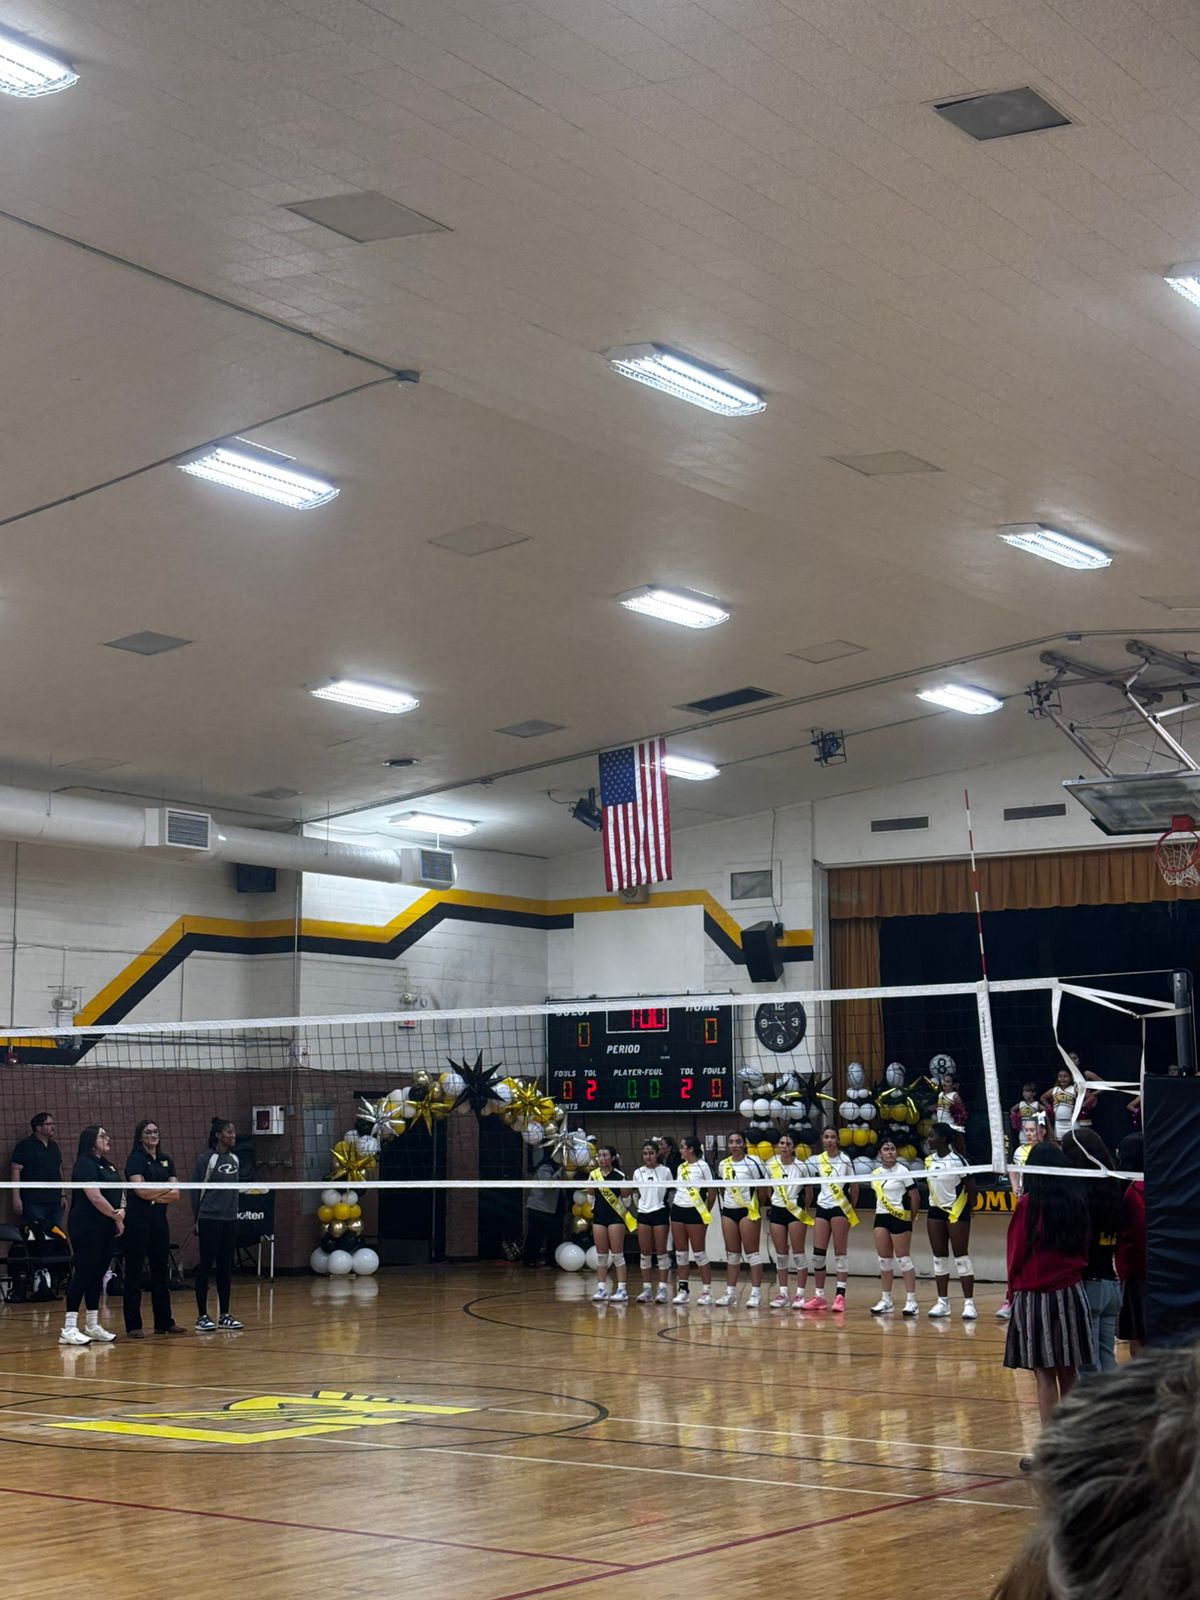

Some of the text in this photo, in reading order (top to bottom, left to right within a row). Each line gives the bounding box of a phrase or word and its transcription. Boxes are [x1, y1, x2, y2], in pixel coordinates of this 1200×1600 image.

[774, 1002, 785, 1011] 12
[791, 1017, 800, 1027] 3
[578, 1022, 591, 1047] 0
[704, 1017, 718, 1044] 0
[776, 1034, 785, 1045] 6
[606, 1044, 641, 1055] PERIOD
[583, 1069, 597, 1077] TOL
[613, 1068, 664, 1077] PLAYER-FOUL
[680, 1066, 727, 1076] TOL FOULS
[585, 1079, 597, 1101] 2
[680, 1077, 693, 1099] 2
[614, 1101, 641, 1110] MATCH
[701, 1100, 729, 1109] POINTS
